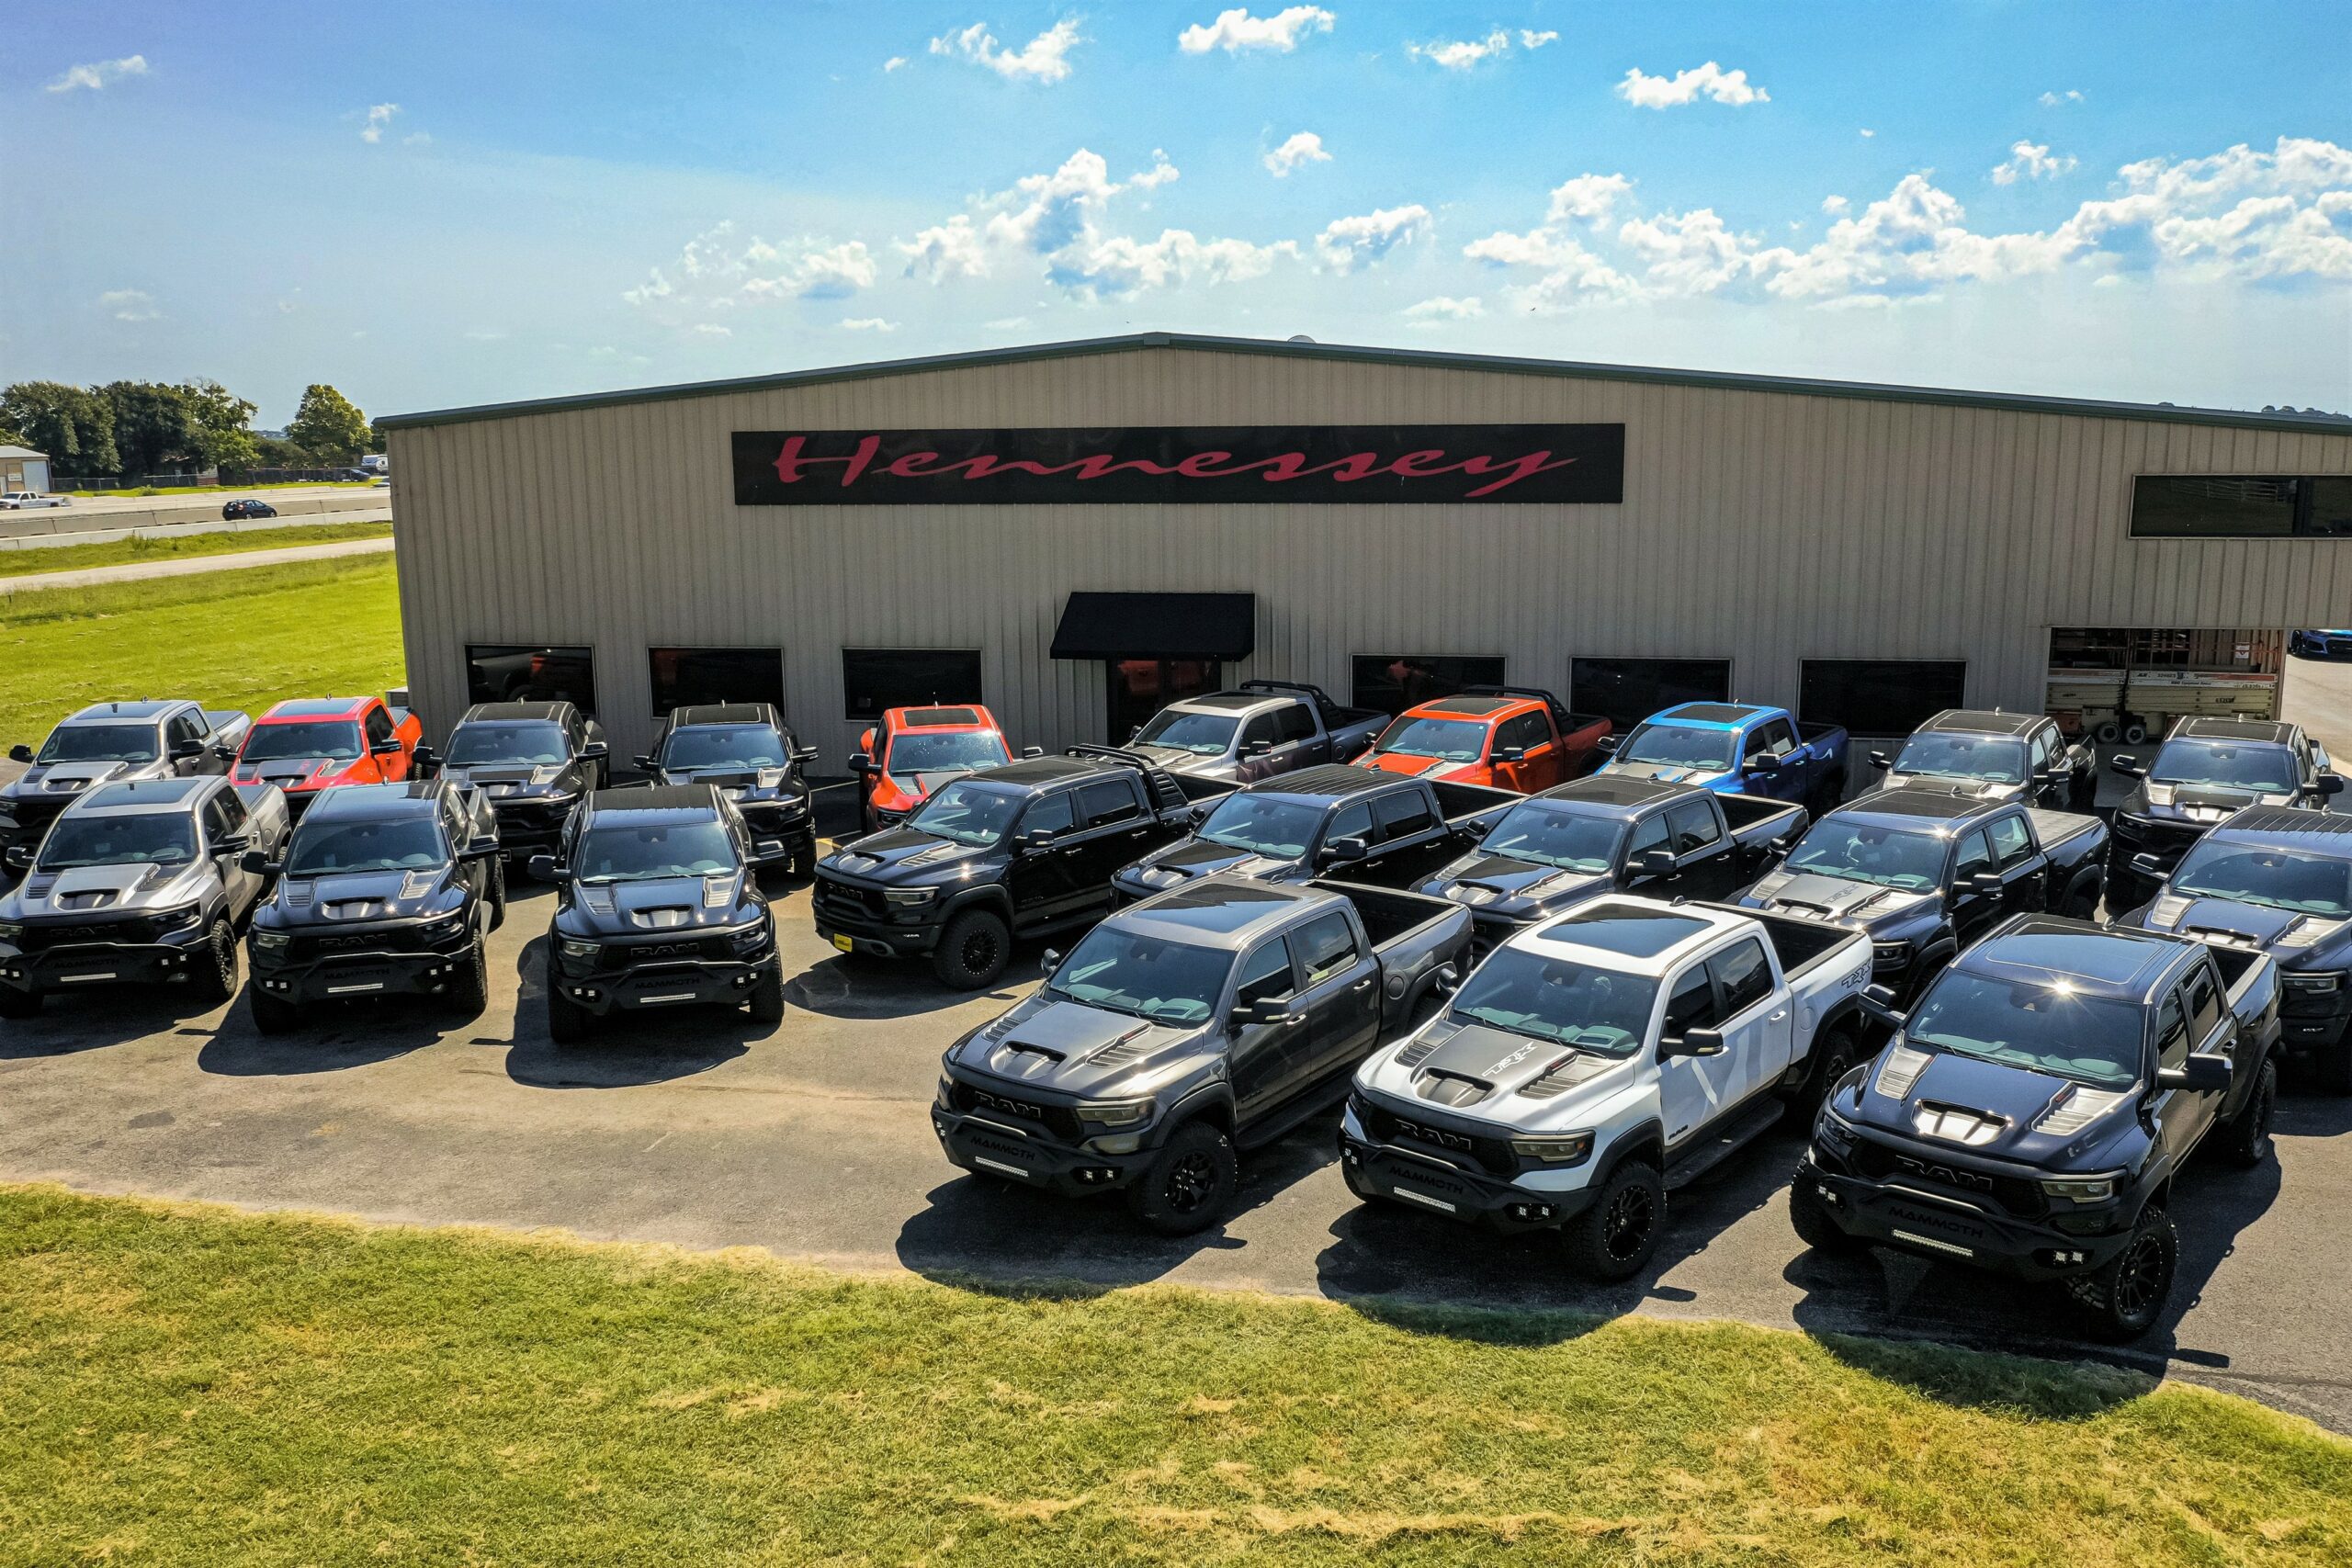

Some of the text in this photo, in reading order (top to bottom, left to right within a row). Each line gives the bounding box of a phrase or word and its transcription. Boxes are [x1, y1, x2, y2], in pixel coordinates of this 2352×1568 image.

[773, 436, 1578, 498] Hennessey
[1821, 883, 1859, 905] TRX
[319, 933, 389, 949] RAM
[630, 943, 700, 956] RAM
[324, 967, 390, 979] MAMMOTH
[634, 976, 700, 990] MAMMOTH
[1481, 1040, 1538, 1077] TRX
[974, 1090, 1041, 1119] RAM
[970, 1135, 1035, 1160] MAMMOTH
[1395, 1118, 1471, 1150] RAM
[1388, 1166, 1464, 1193] MAMMOTH
[1895, 1155, 1992, 1190] RAM
[1889, 1206, 1983, 1238] MAMMOTH
